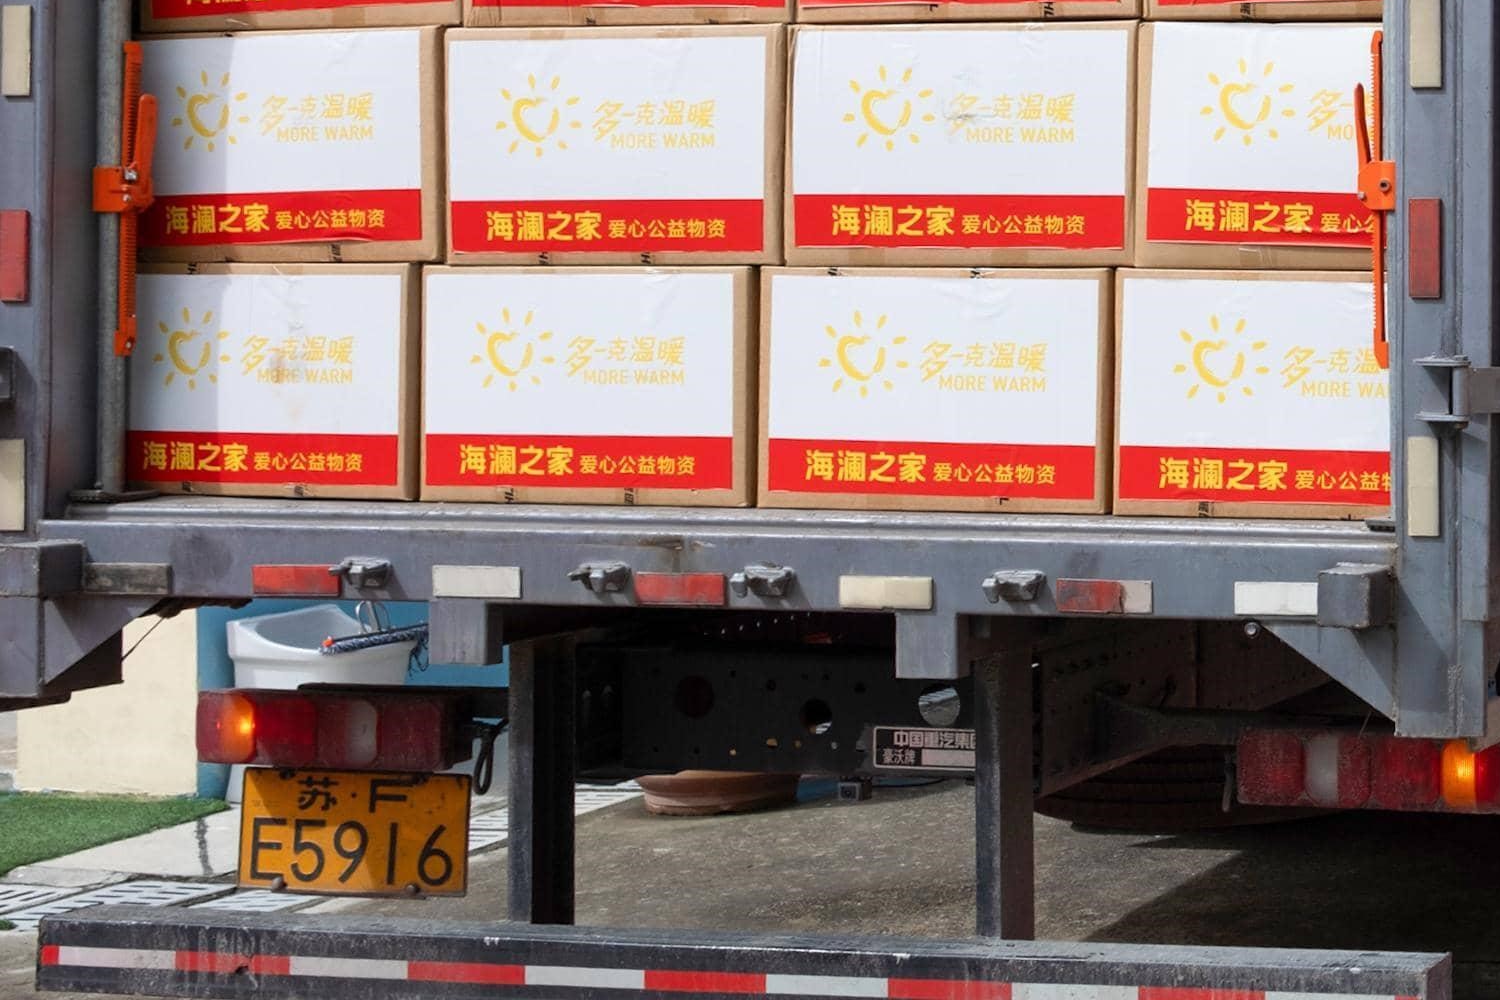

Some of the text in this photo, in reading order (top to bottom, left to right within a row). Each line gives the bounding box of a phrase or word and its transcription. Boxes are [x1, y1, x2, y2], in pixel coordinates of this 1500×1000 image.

[277, 124, 373, 143] MORE WARM
[611, 132, 715, 149] MORE WARM
[965, 127, 1075, 143] MORE WARM
[165, 202, 384, 235] 海澜之家 爱心公益物资
[486, 210, 726, 241] 海澜之家 爱心公益物资
[831, 204, 1085, 236] 海澜之家 爱心公益物资
[1185, 199, 1314, 234] 海澜之家
[257, 367, 353, 384] MORE WARM
[583, 369, 685, 386] MORE WARM
[938, 374, 1046, 393] MORE WARM
[1301, 381, 1351, 398] MORE
[141, 440, 362, 473] 海澜之家 爱心公益物资
[459, 444, 695, 476] 海澜之家 爱心公益物资
[805, 449, 1055, 485] 海澜之家 爱心公益物资
[1159, 457, 1288, 491] 海澜之家
[250, 817, 453, 886] E5916
